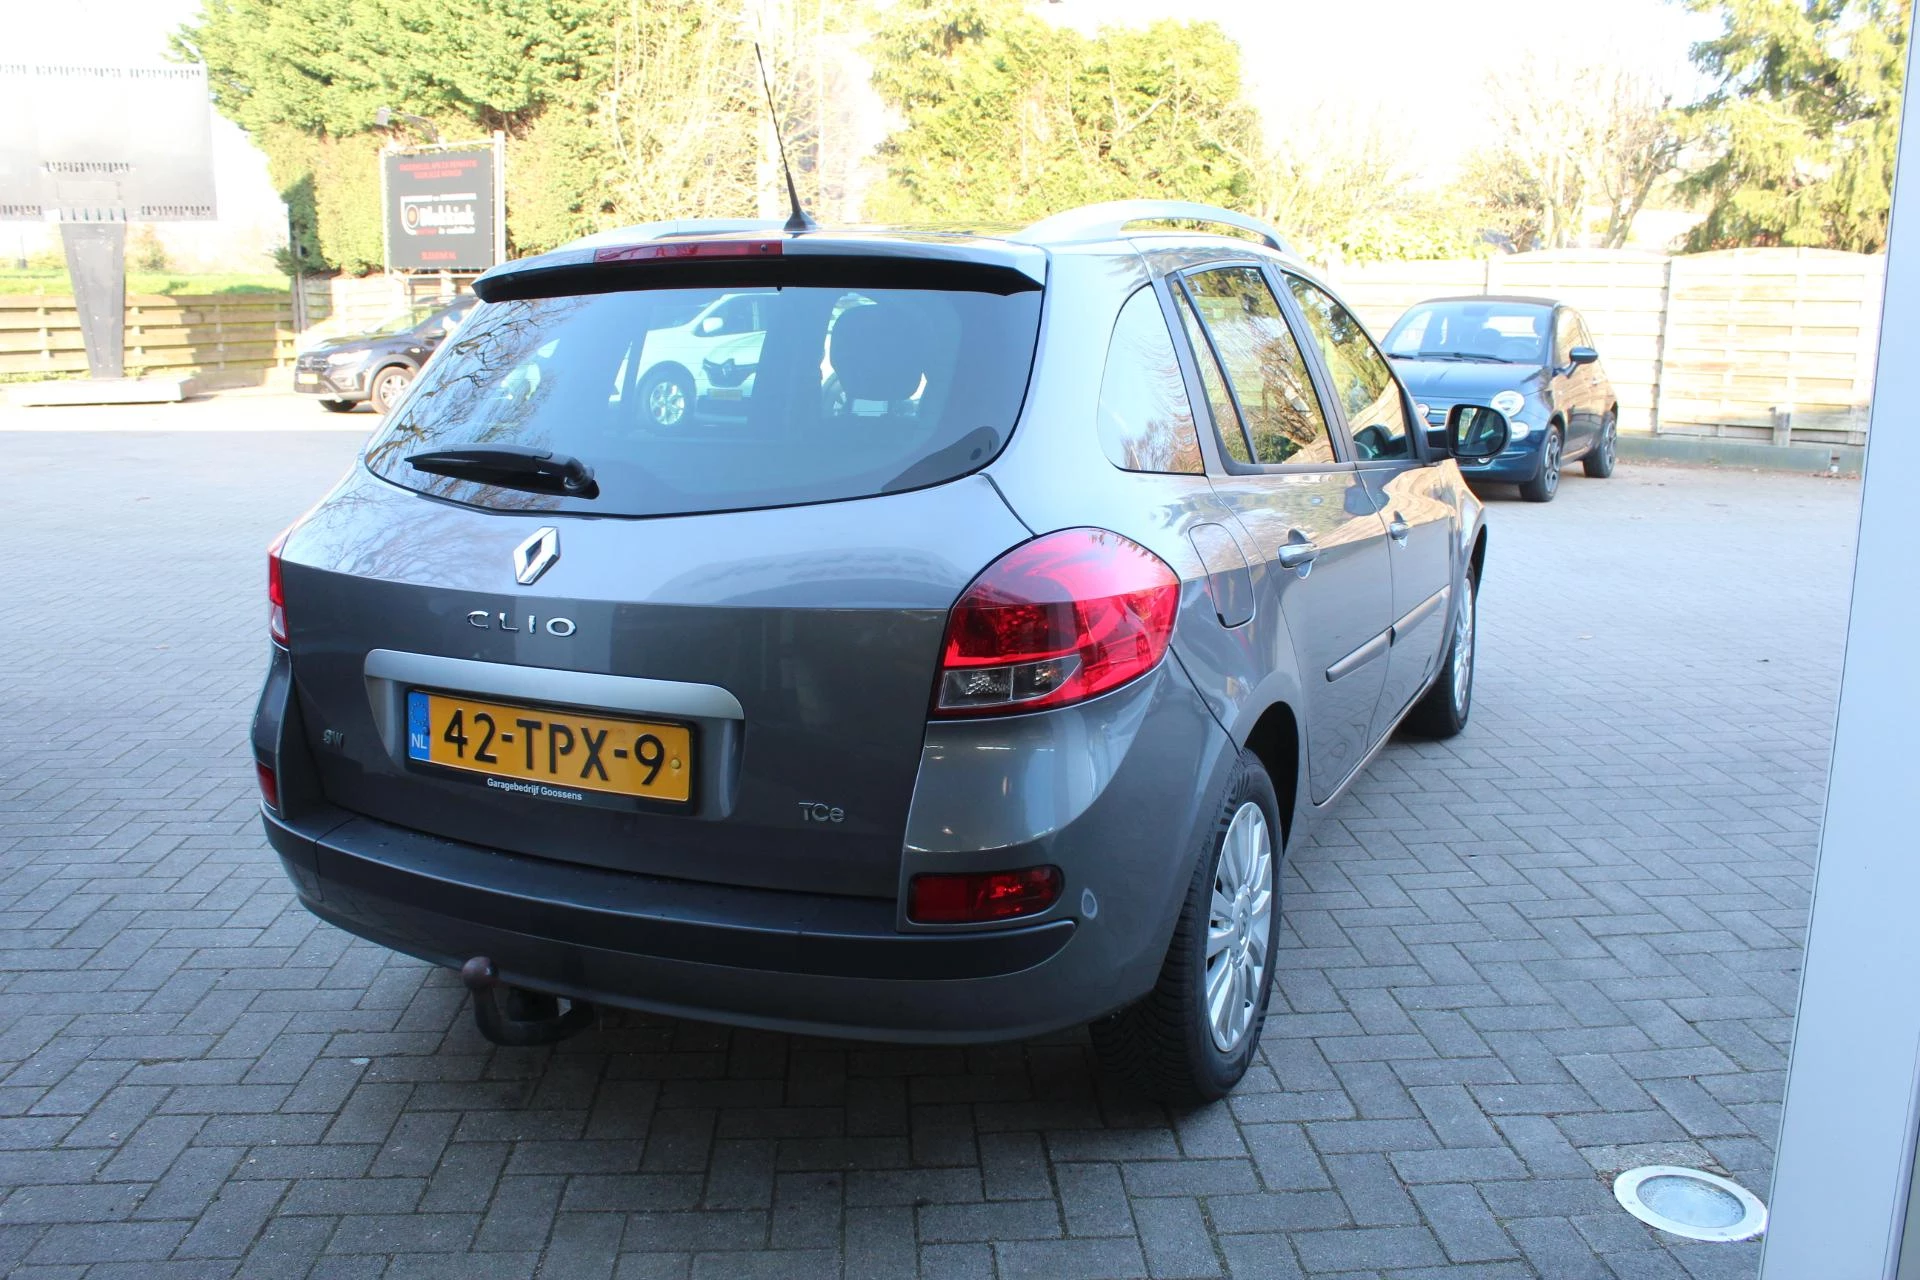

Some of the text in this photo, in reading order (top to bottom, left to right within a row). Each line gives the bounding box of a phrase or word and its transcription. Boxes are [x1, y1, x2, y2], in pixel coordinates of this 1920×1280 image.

[467, 610, 577, 637] CLIO
[411, 733, 427, 750] NL
[444, 708, 665, 786] 42-TPX-9
[487, 778, 582, 801] Garagebedrijf Goossens
[798, 802, 845, 823] TCe
